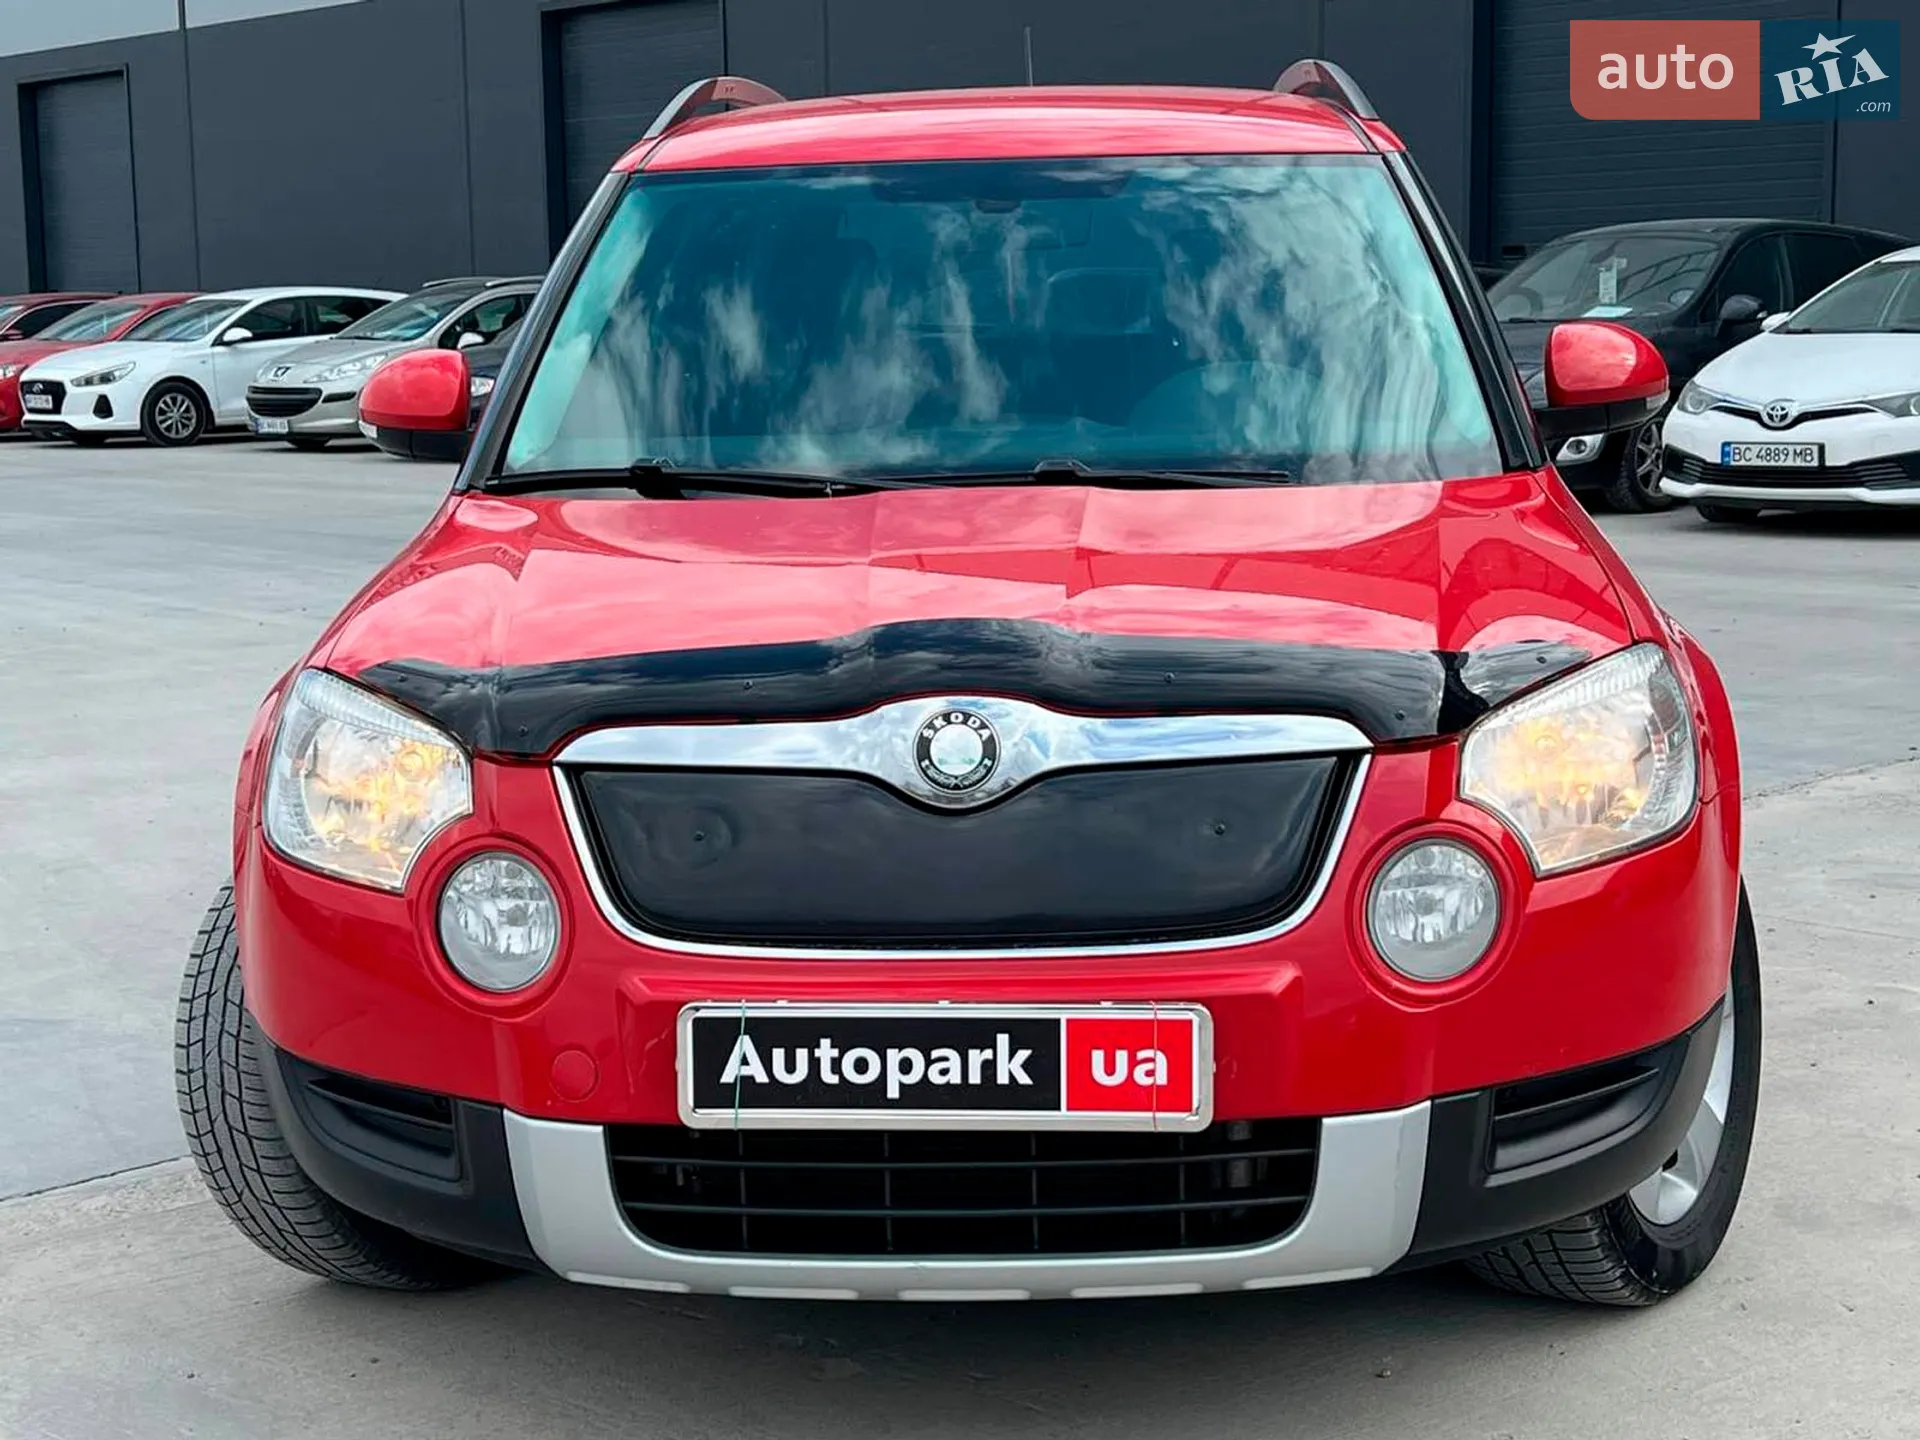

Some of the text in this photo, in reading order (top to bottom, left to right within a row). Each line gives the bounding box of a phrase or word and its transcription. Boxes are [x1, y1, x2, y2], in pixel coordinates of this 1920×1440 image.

[1731, 446, 1814, 464] BC 4889 MB
[719, 1033, 1168, 1100] Autopark ua
